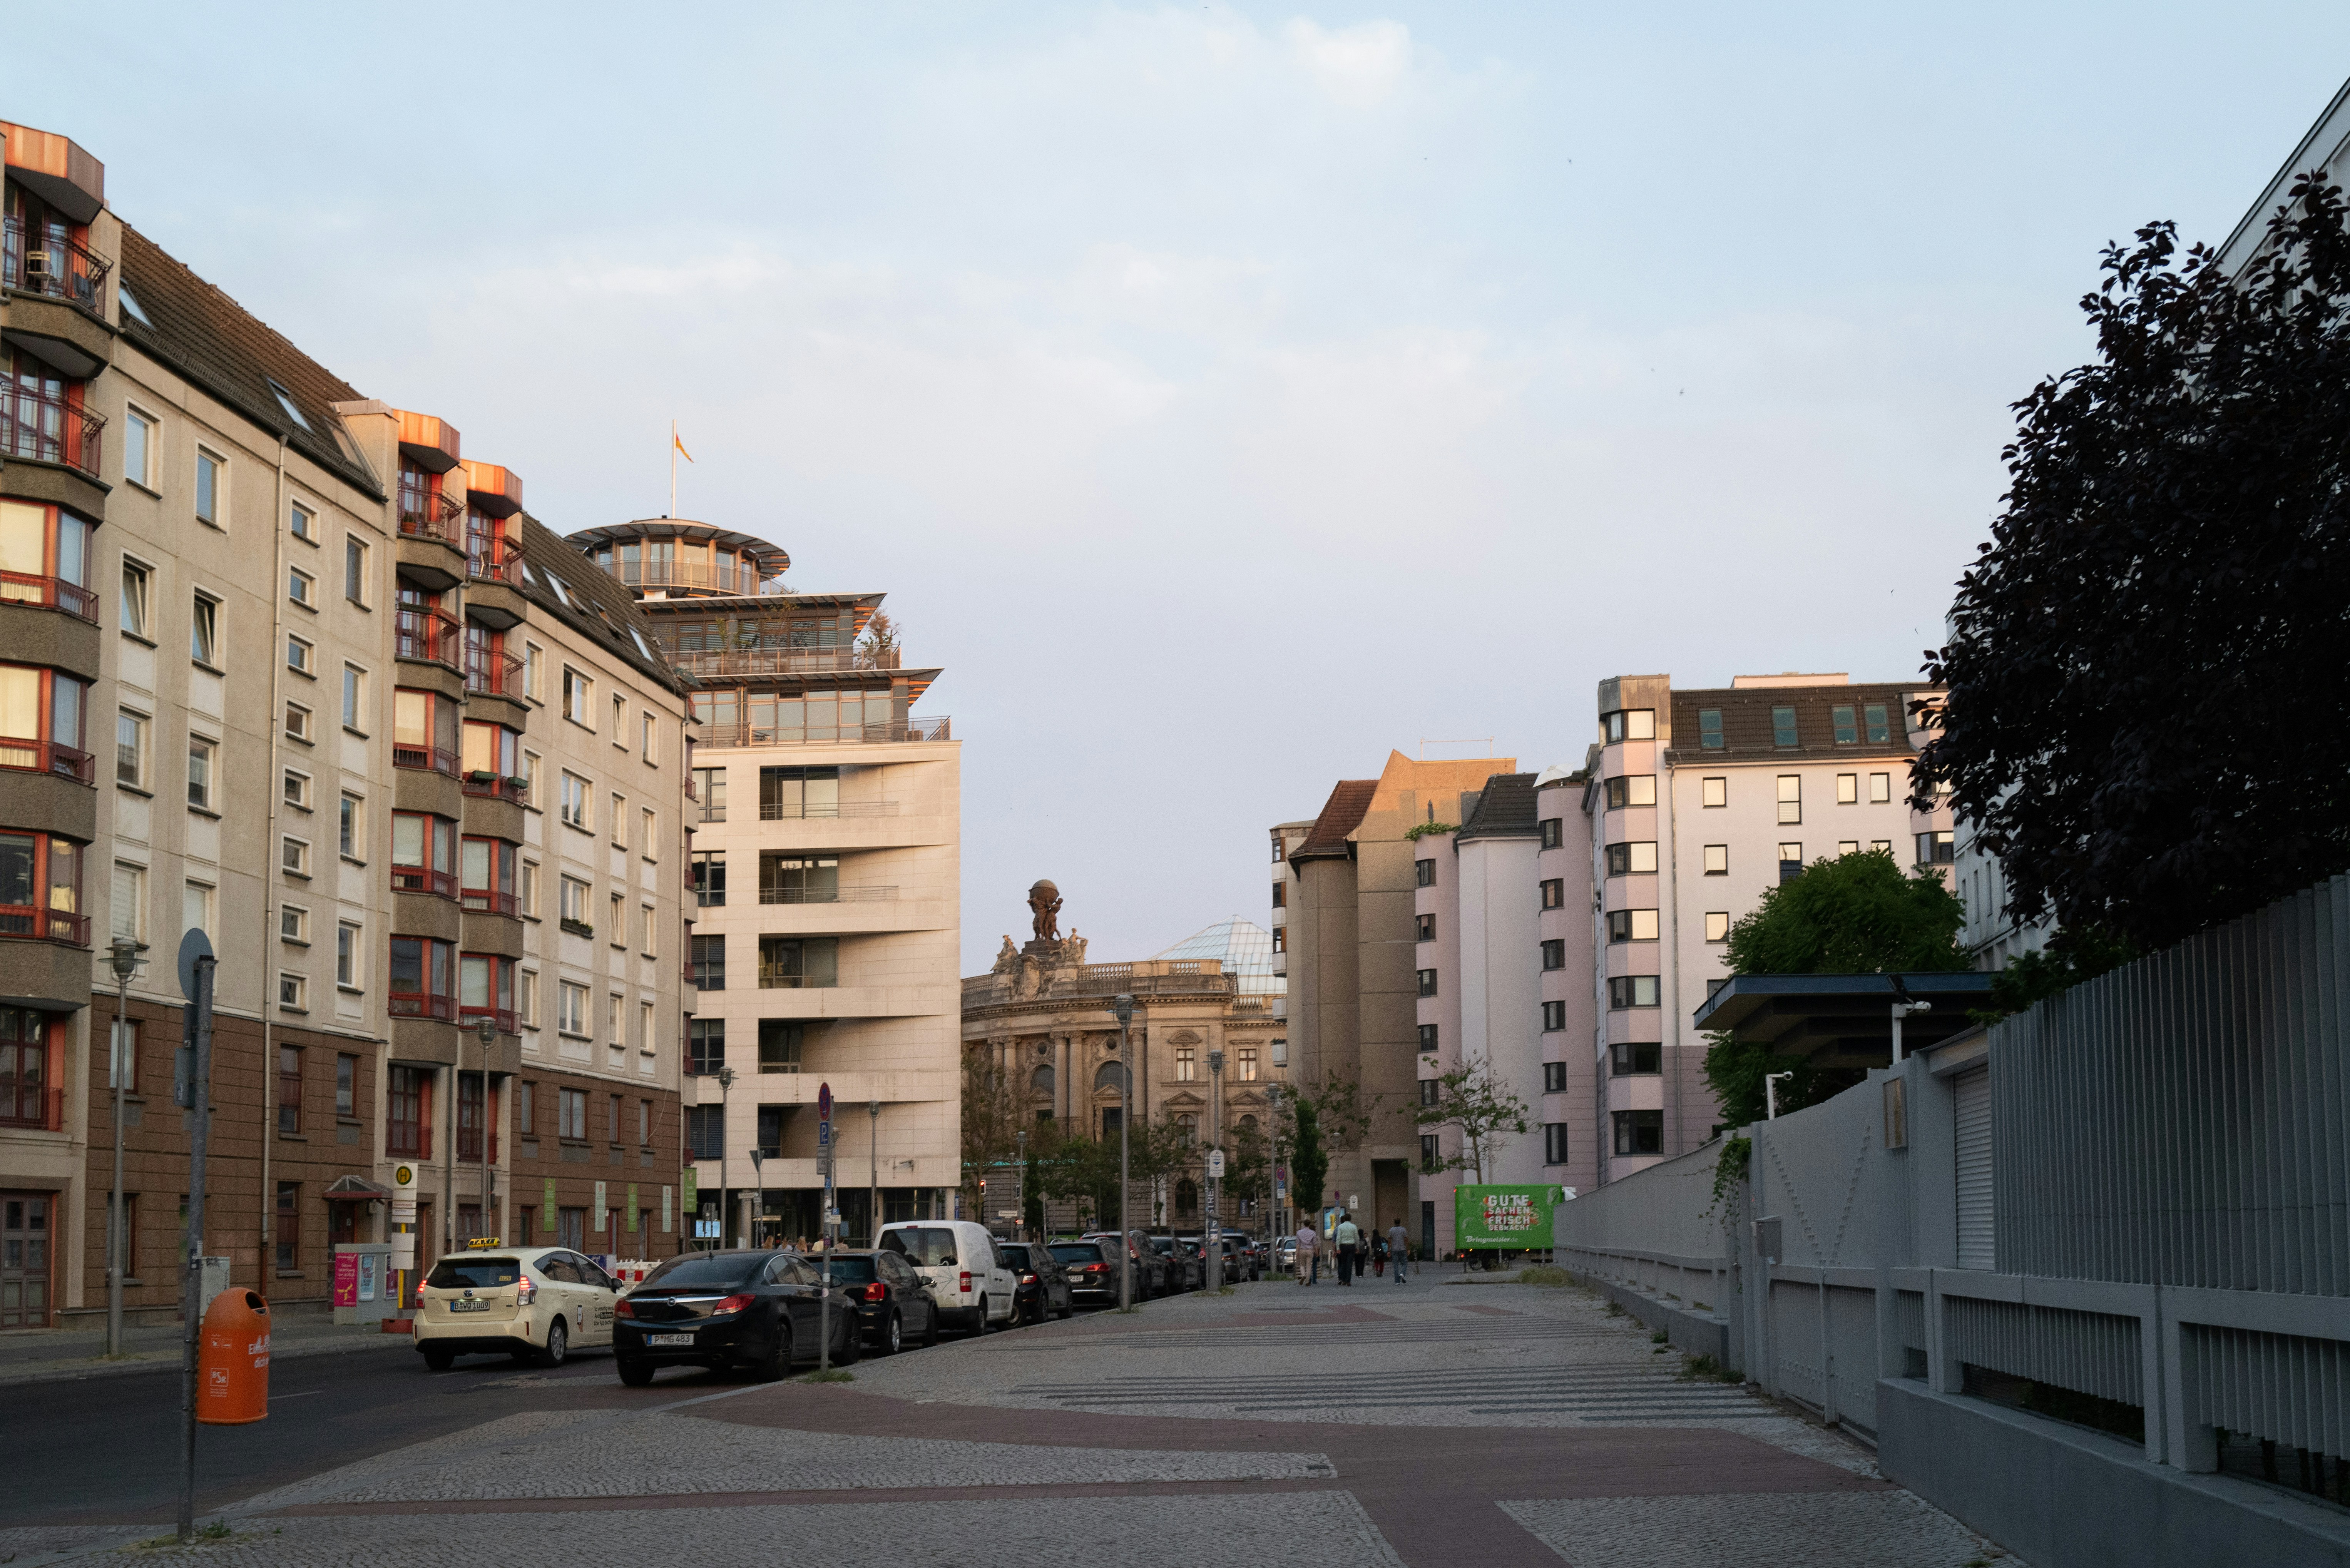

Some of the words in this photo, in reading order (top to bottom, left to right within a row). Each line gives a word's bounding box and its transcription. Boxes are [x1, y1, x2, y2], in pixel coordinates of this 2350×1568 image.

[400, 1170, 407, 1181] H
[1488, 1195, 1529, 1206] GUTE
[1488, 1216, 1530, 1224] FRISCH
[212, 1371, 227, 1383] BSR
